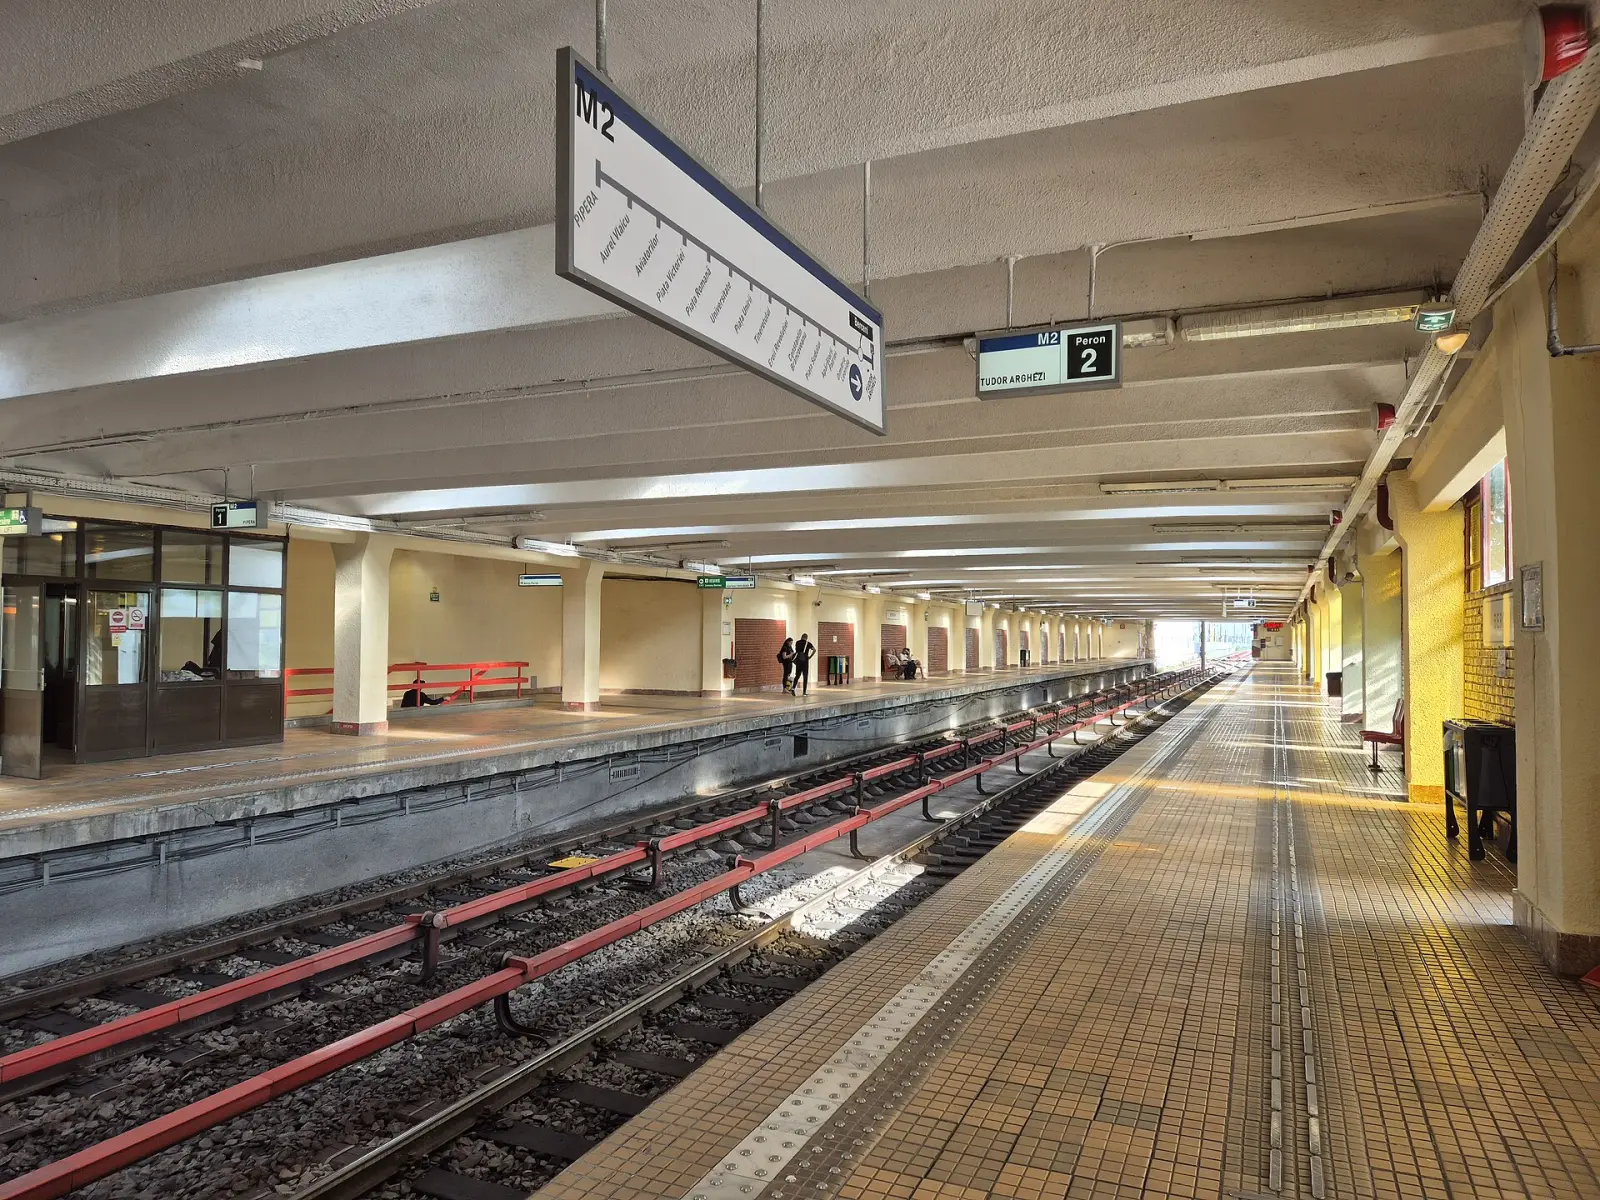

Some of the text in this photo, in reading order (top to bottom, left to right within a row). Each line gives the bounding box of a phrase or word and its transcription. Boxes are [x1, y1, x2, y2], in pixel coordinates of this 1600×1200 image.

[576, 77, 615, 143] M2
[574, 190, 598, 228] PIPERA
[600, 214, 631, 264] Aurel Vlaicu
[635, 234, 660, 277] Aviatorilor
[667, 248, 685, 282] Victoriei
[694, 265, 712, 298] Romană
[710, 281, 732, 324] Universitate
[754, 305, 771, 344] Tineretului
[1037, 331, 1059, 346] M2
[1075, 336, 1106, 346] Peron
[1080, 348, 1097, 373] 2
[980, 372, 1046, 387] TUDOR ARGHEZI
[217, 513, 222, 524] 1
